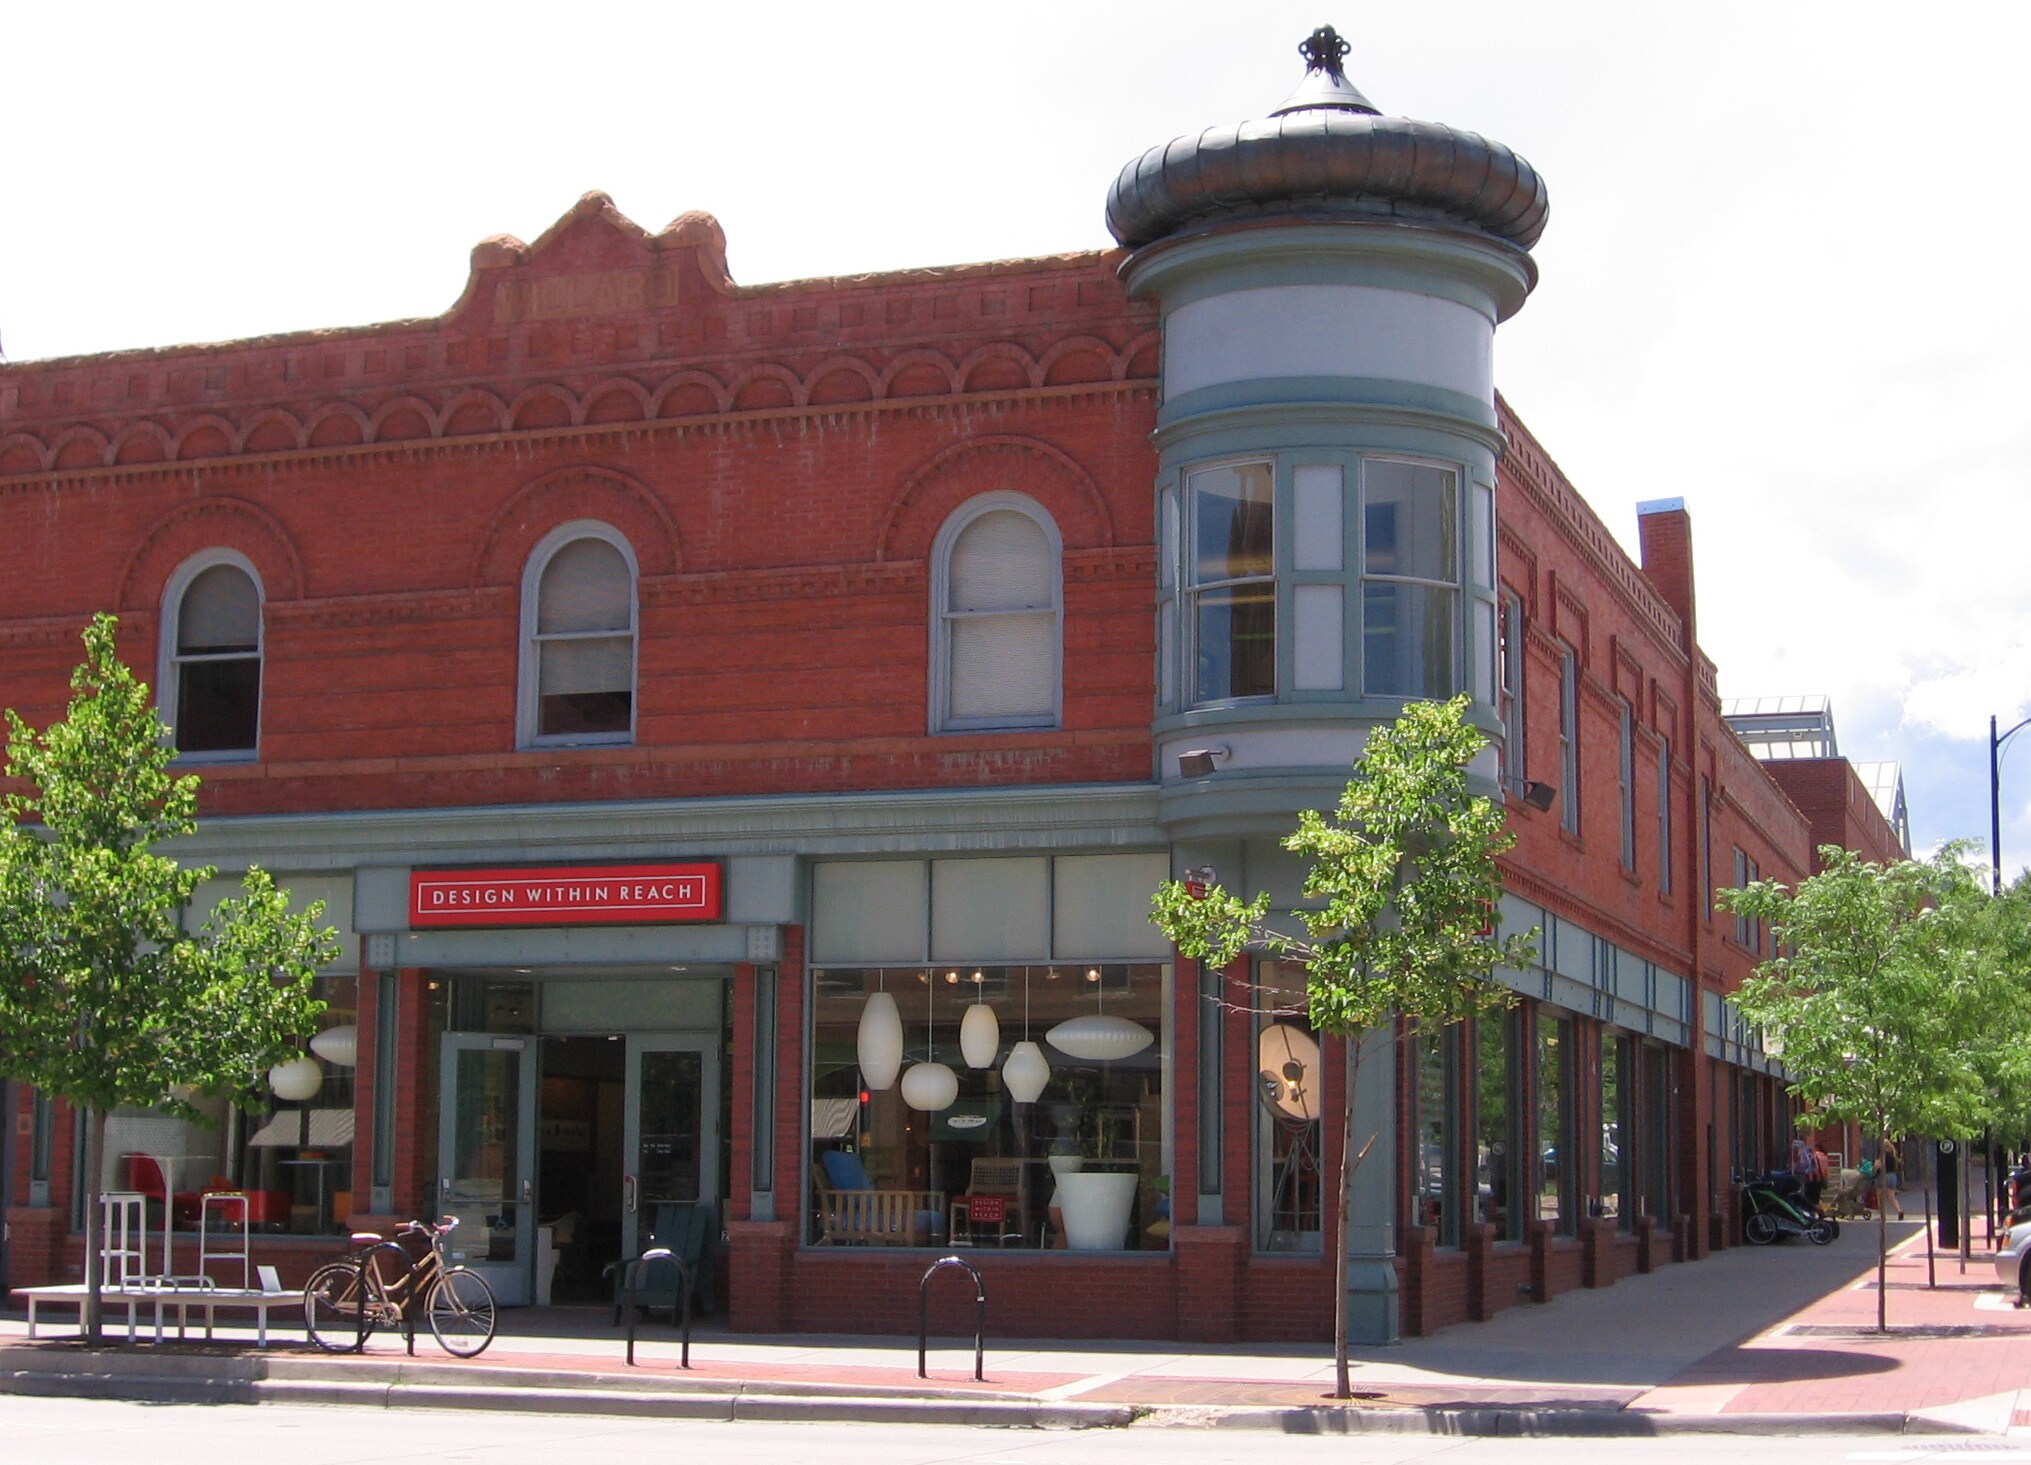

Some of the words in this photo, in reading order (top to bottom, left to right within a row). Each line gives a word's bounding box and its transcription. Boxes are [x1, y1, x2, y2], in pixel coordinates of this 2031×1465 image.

[433, 888, 514, 905] DESIGN
[526, 886, 608, 902] WITHIN
[619, 884, 691, 900] REACH
